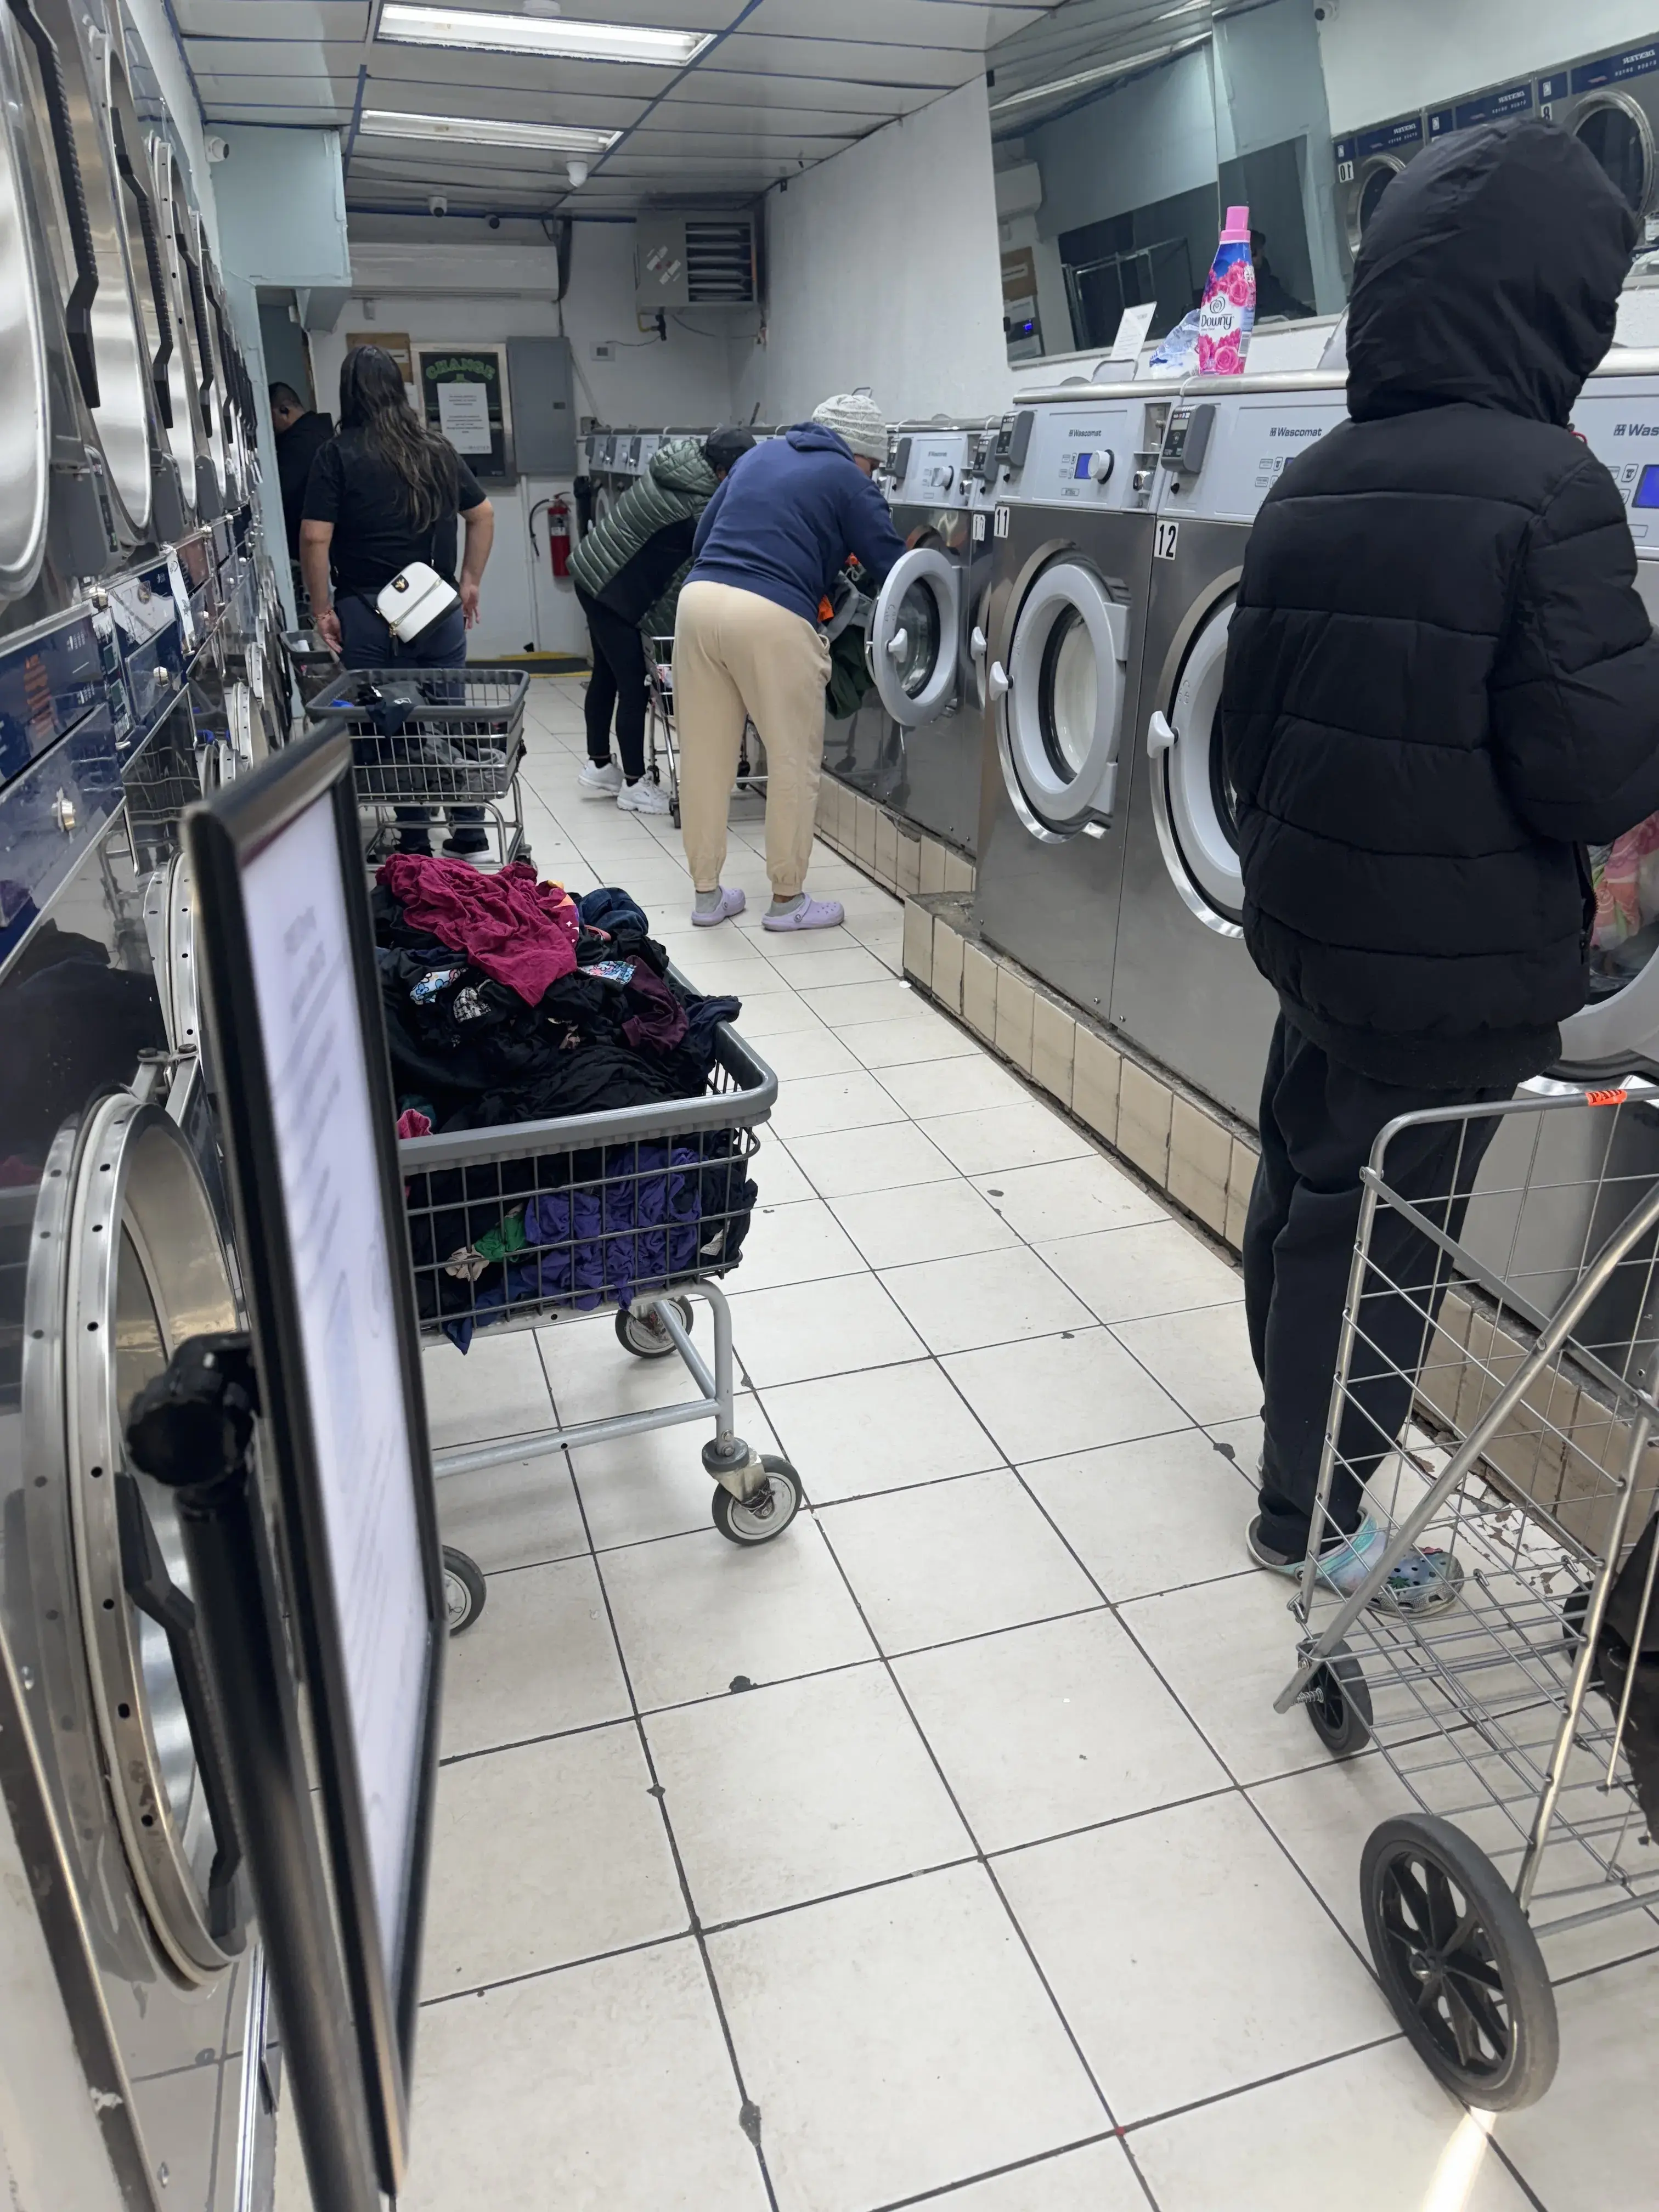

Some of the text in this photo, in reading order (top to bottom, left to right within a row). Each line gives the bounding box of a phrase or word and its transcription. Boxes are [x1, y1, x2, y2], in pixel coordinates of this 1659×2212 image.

[1201, 314, 1232, 330] Downy
[426, 358, 495, 380] CHANGE
[1277, 427, 1323, 437] Wascomat
[997, 509, 1008, 536] 11
[1159, 524, 1176, 558] 12
[1589, 1089, 1622, 1103] PAID
